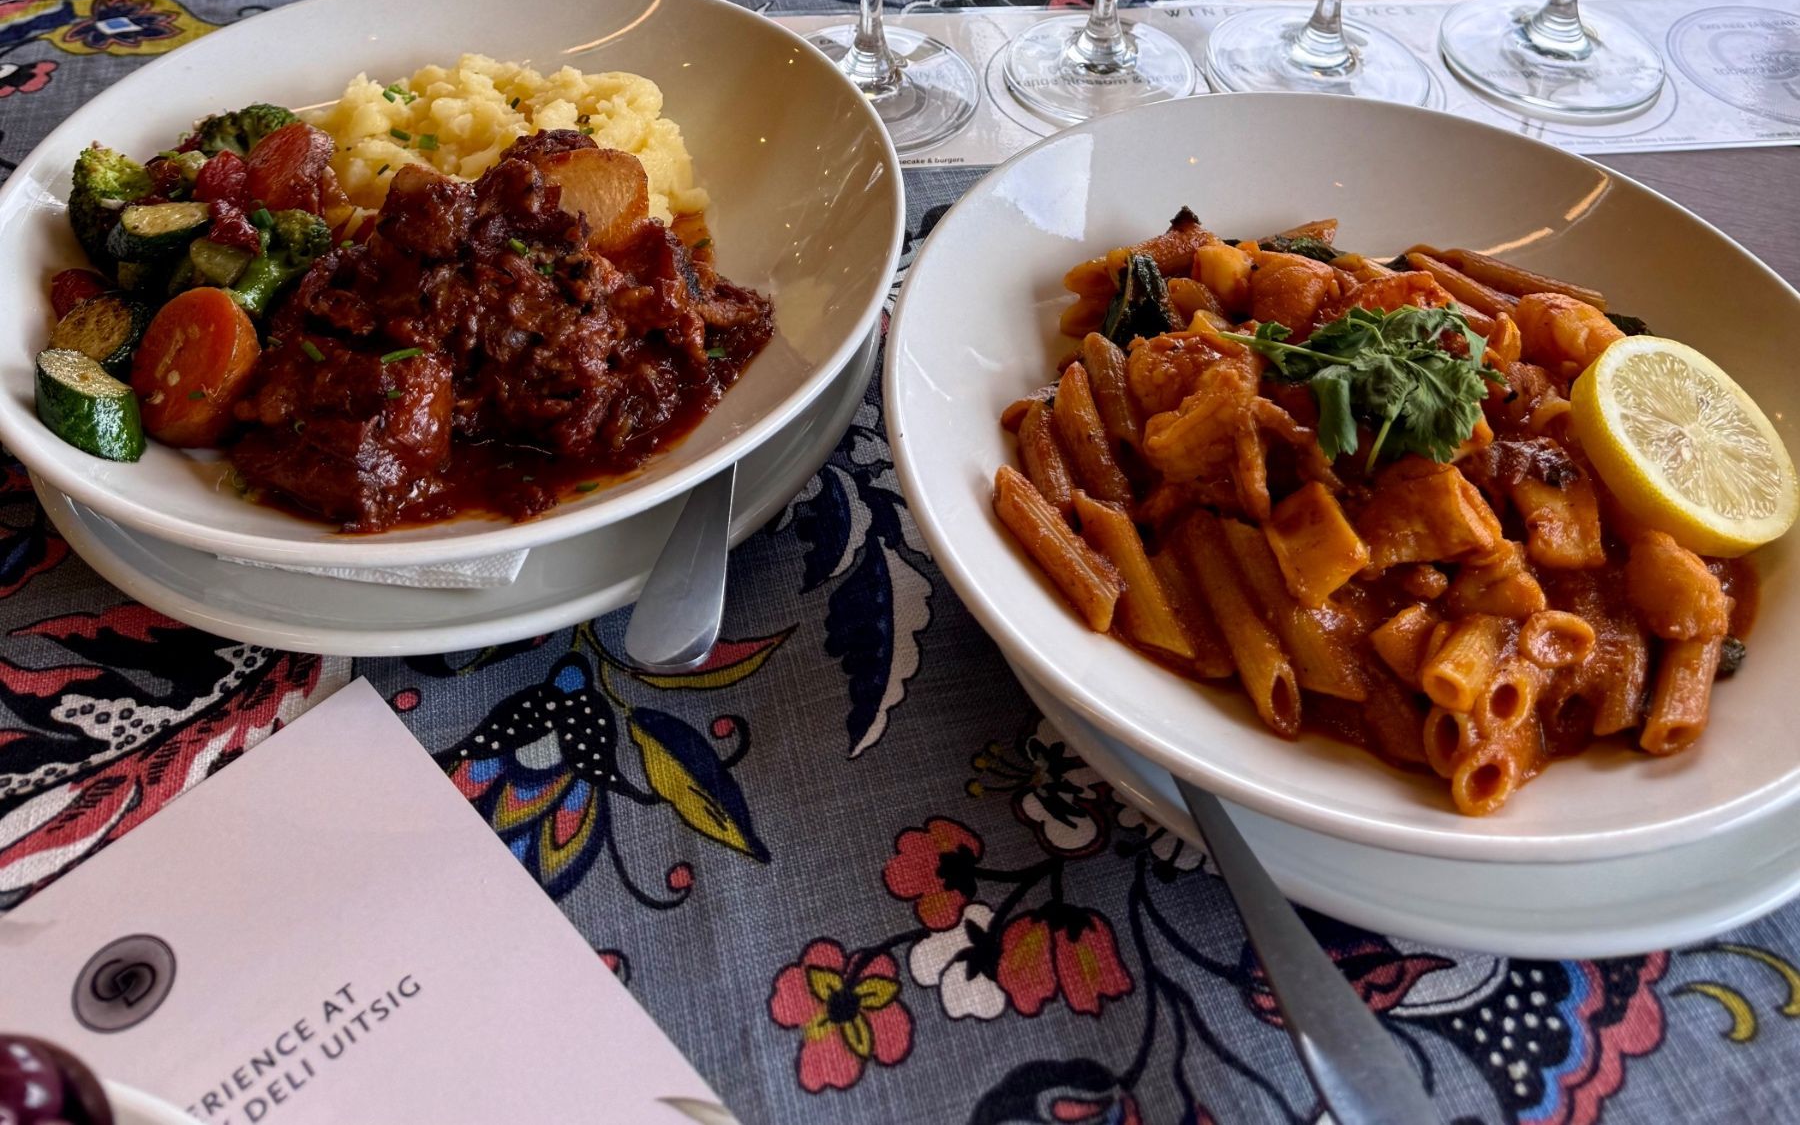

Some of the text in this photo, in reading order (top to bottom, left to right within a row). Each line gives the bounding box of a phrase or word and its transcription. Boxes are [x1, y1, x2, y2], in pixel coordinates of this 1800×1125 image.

[243, 974, 422, 1124] DELI UITSIG
[322, 982, 358, 1024] AT
